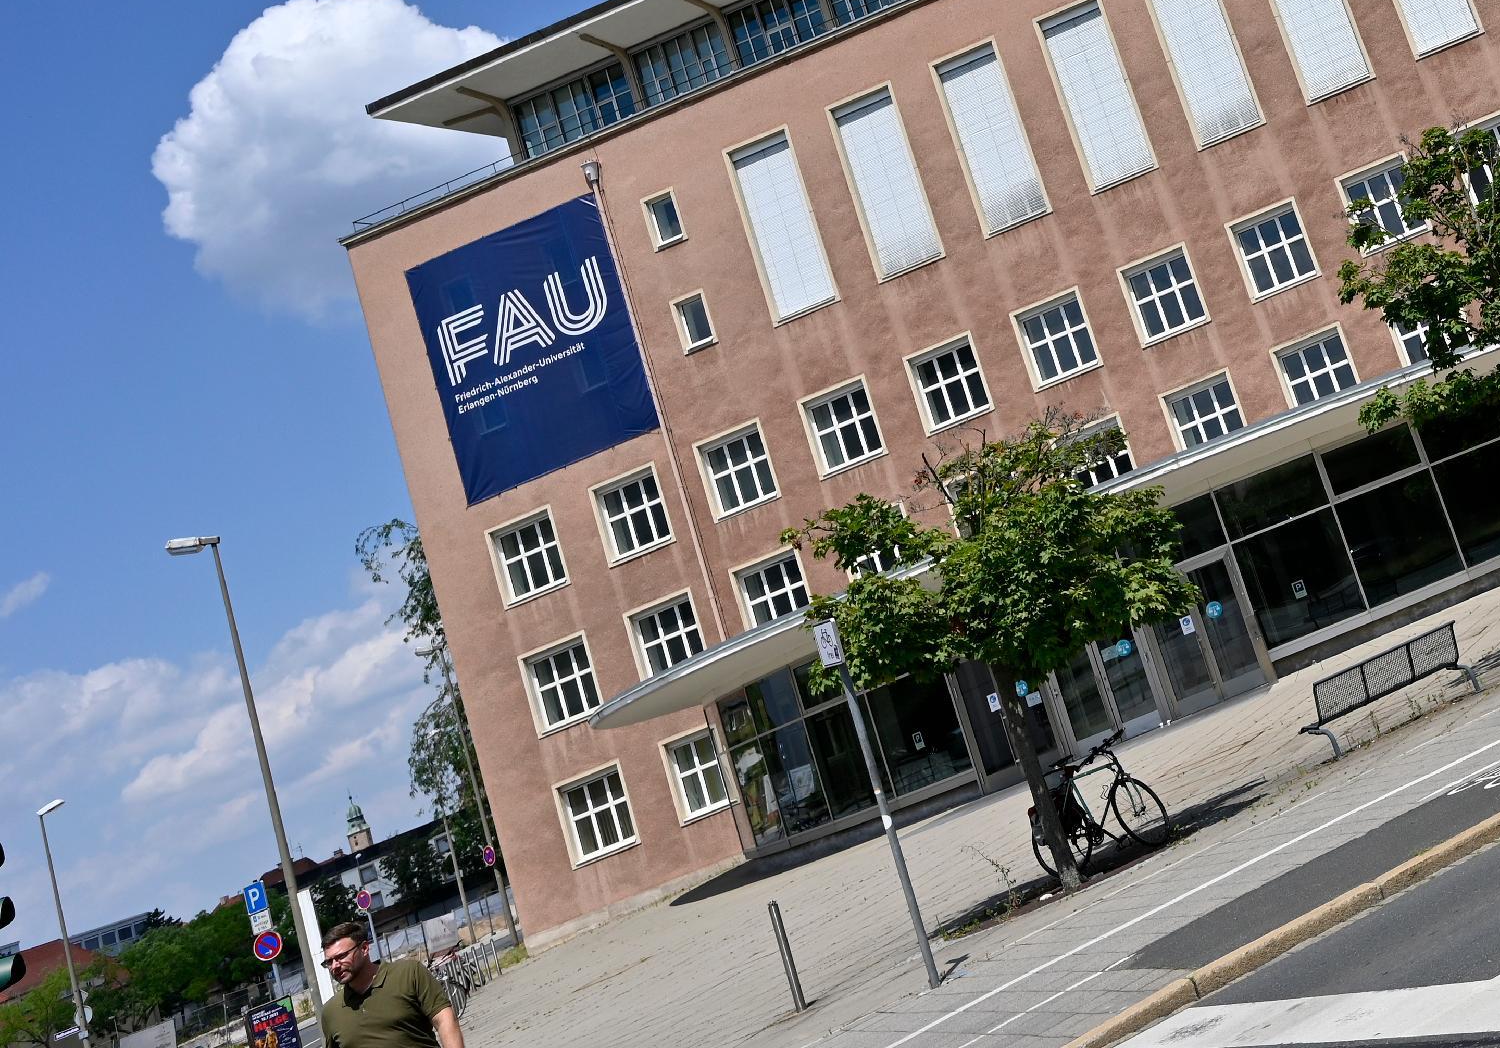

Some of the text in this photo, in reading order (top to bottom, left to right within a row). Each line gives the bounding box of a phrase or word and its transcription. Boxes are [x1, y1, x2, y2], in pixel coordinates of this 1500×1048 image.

[437, 256, 607, 386] FAU
[455, 342, 585, 403] Friedrich-Alexander-Universität
[458, 375, 538, 414] Erlangen-Nürnberg
[248, 888, 259, 909] P
